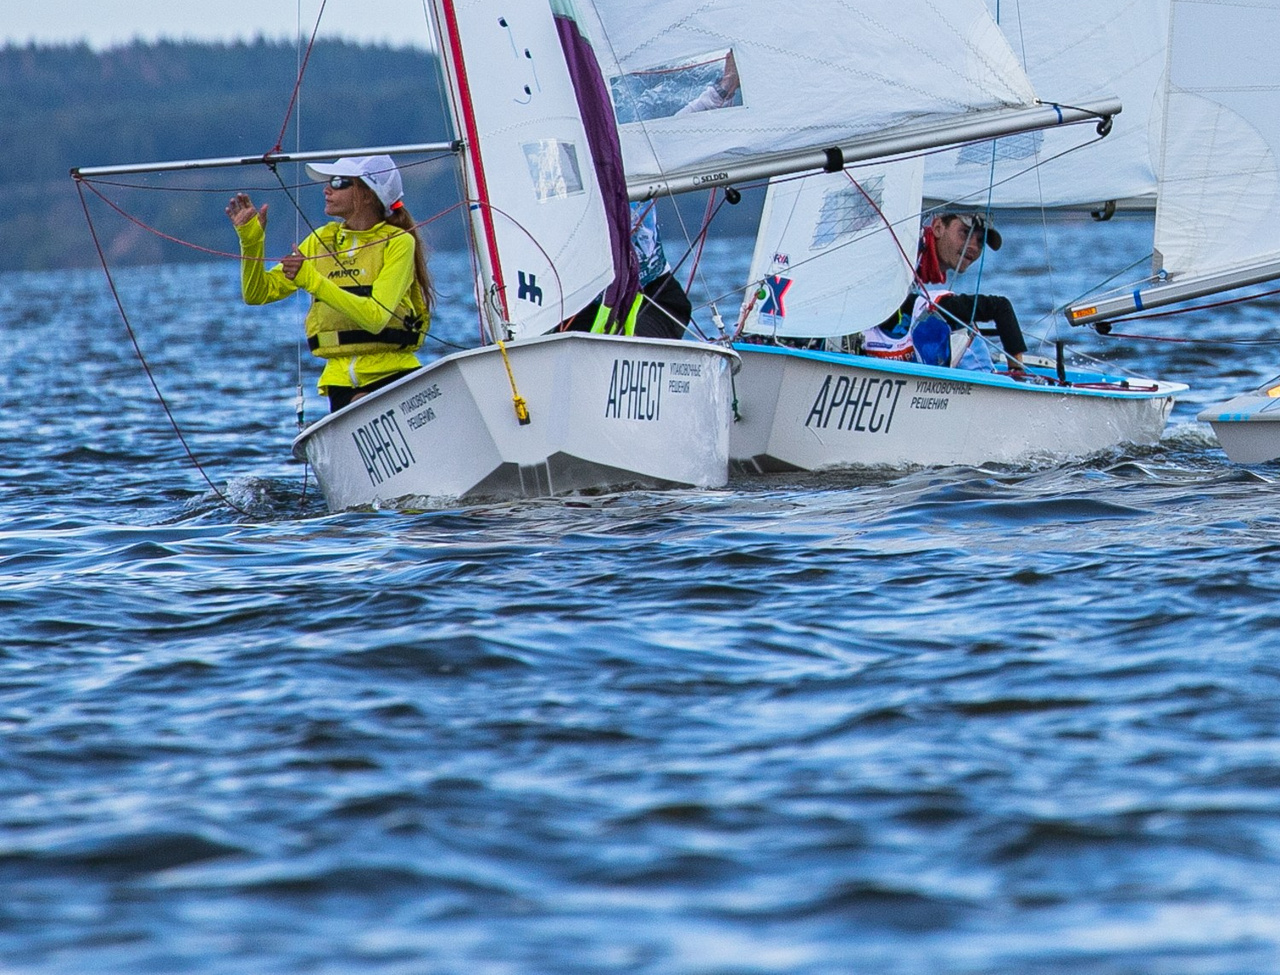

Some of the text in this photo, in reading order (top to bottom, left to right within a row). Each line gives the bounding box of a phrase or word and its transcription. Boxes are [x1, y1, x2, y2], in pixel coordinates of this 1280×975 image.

[605, 359, 665, 421] АРНЕСТ
[805, 374, 907, 434] АРНЕСТ
[910, 396, 950, 410] РЕШЕНИЯ
[915, 380, 974, 396] УПАКОВОЧНЫЕ
[351, 409, 416, 487] АРНЕСТ
